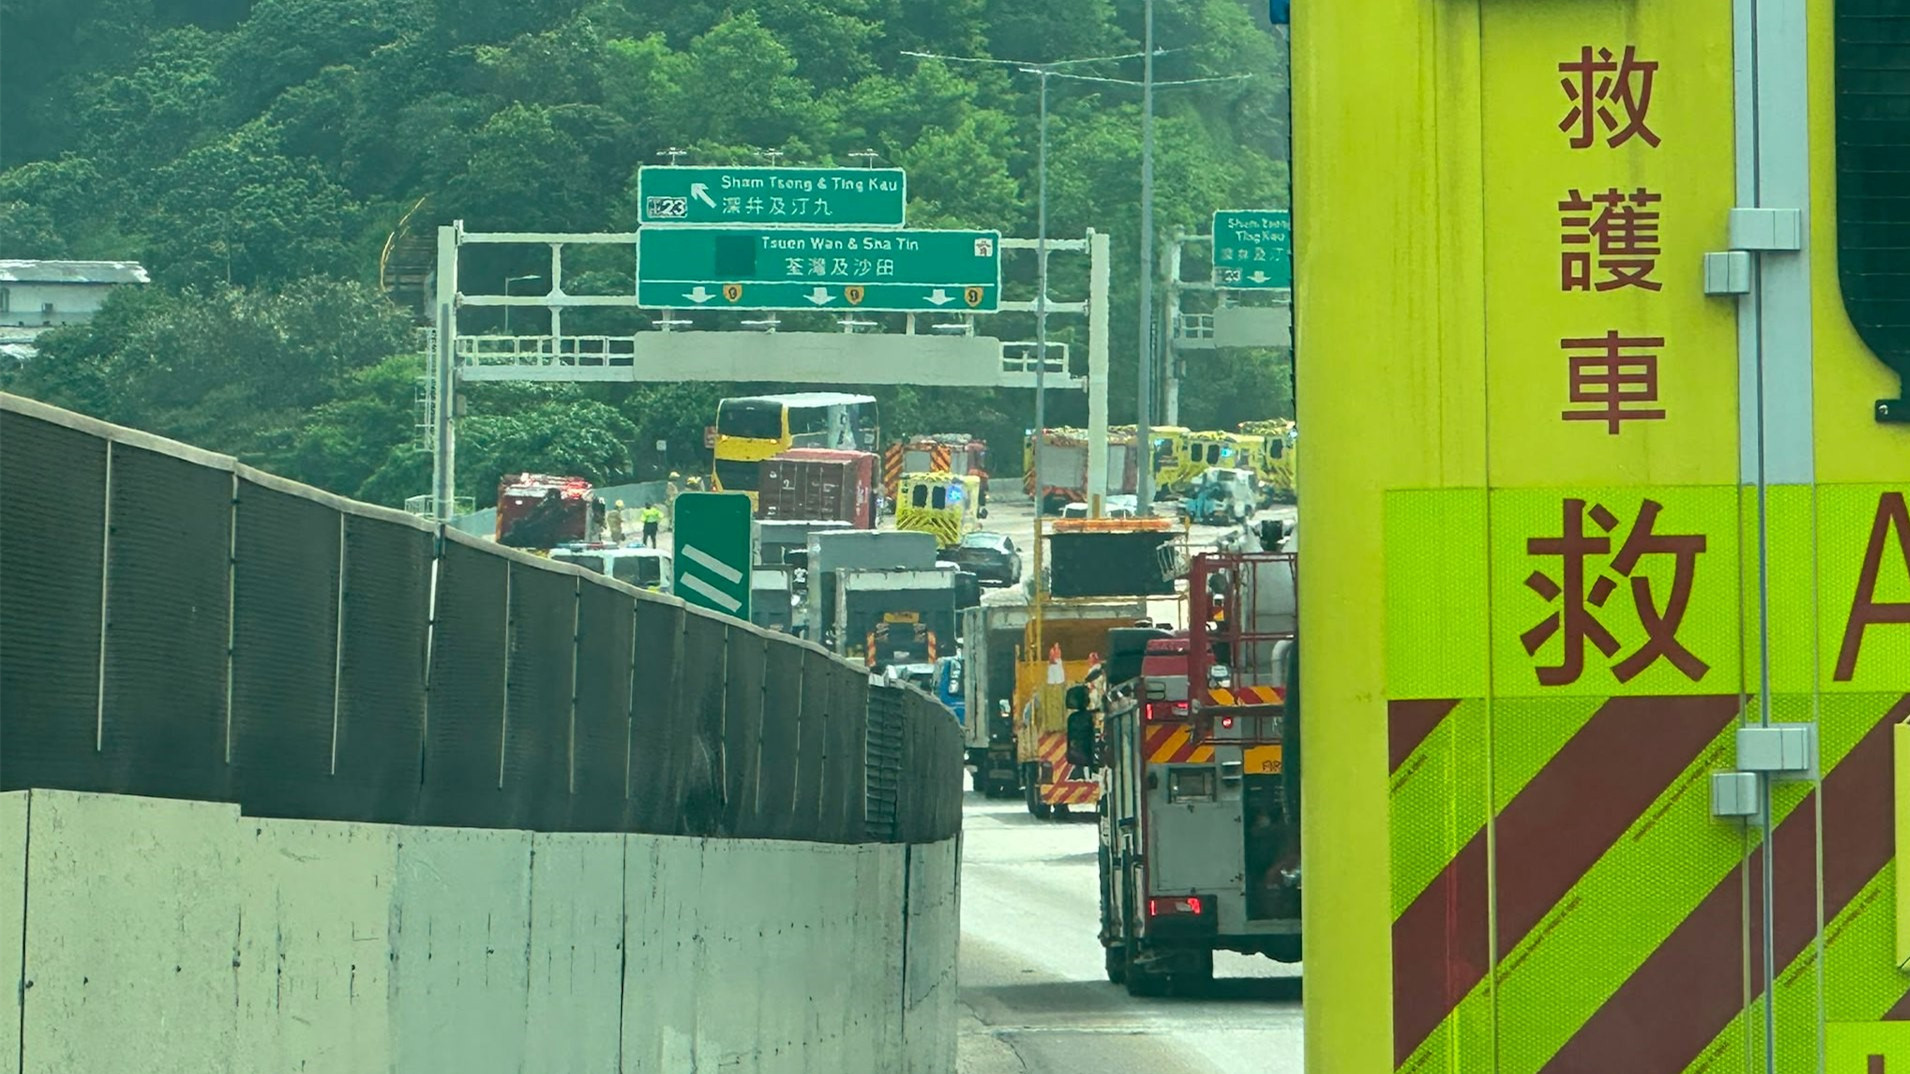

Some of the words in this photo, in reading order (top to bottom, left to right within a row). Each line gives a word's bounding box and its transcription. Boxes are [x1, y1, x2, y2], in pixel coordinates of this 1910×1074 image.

[721, 175, 763, 189] Sham
[817, 177, 827, 189] &
[832, 177, 864, 192] Ting
[868, 178, 898, 191] Kau
[722, 197, 833, 215] 深井及汀九
[762, 236, 805, 249] Tsuen
[810, 237, 843, 250] Wan
[847, 238, 858, 250] &
[895, 237, 919, 250] Tin
[1558, 45, 1666, 435] 救護車
[785, 257, 894, 277] 荃灣及沙田
[1520, 498, 1710, 686] 救
